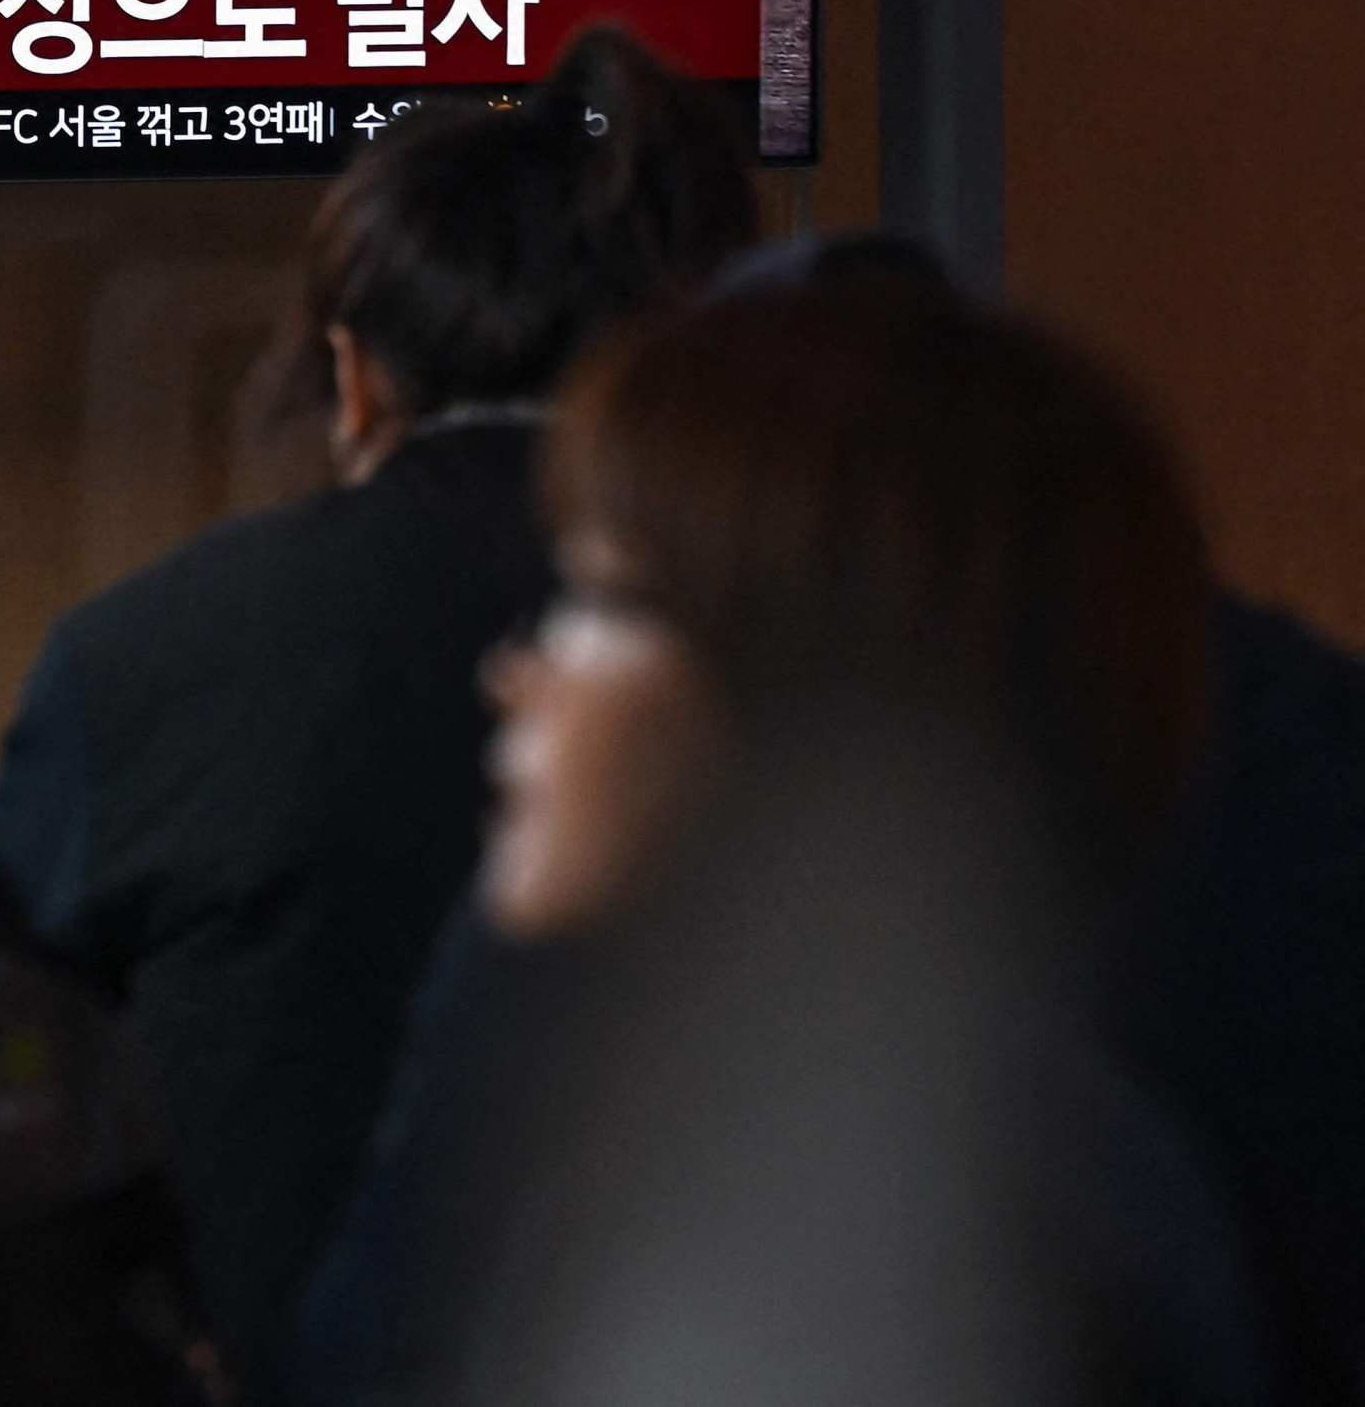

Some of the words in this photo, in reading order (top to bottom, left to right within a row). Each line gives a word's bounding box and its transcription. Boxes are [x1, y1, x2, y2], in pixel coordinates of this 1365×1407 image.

[49, 104, 126, 148] 서울
[136, 103, 213, 147] 꺾고
[223, 100, 323, 145] 3연패
